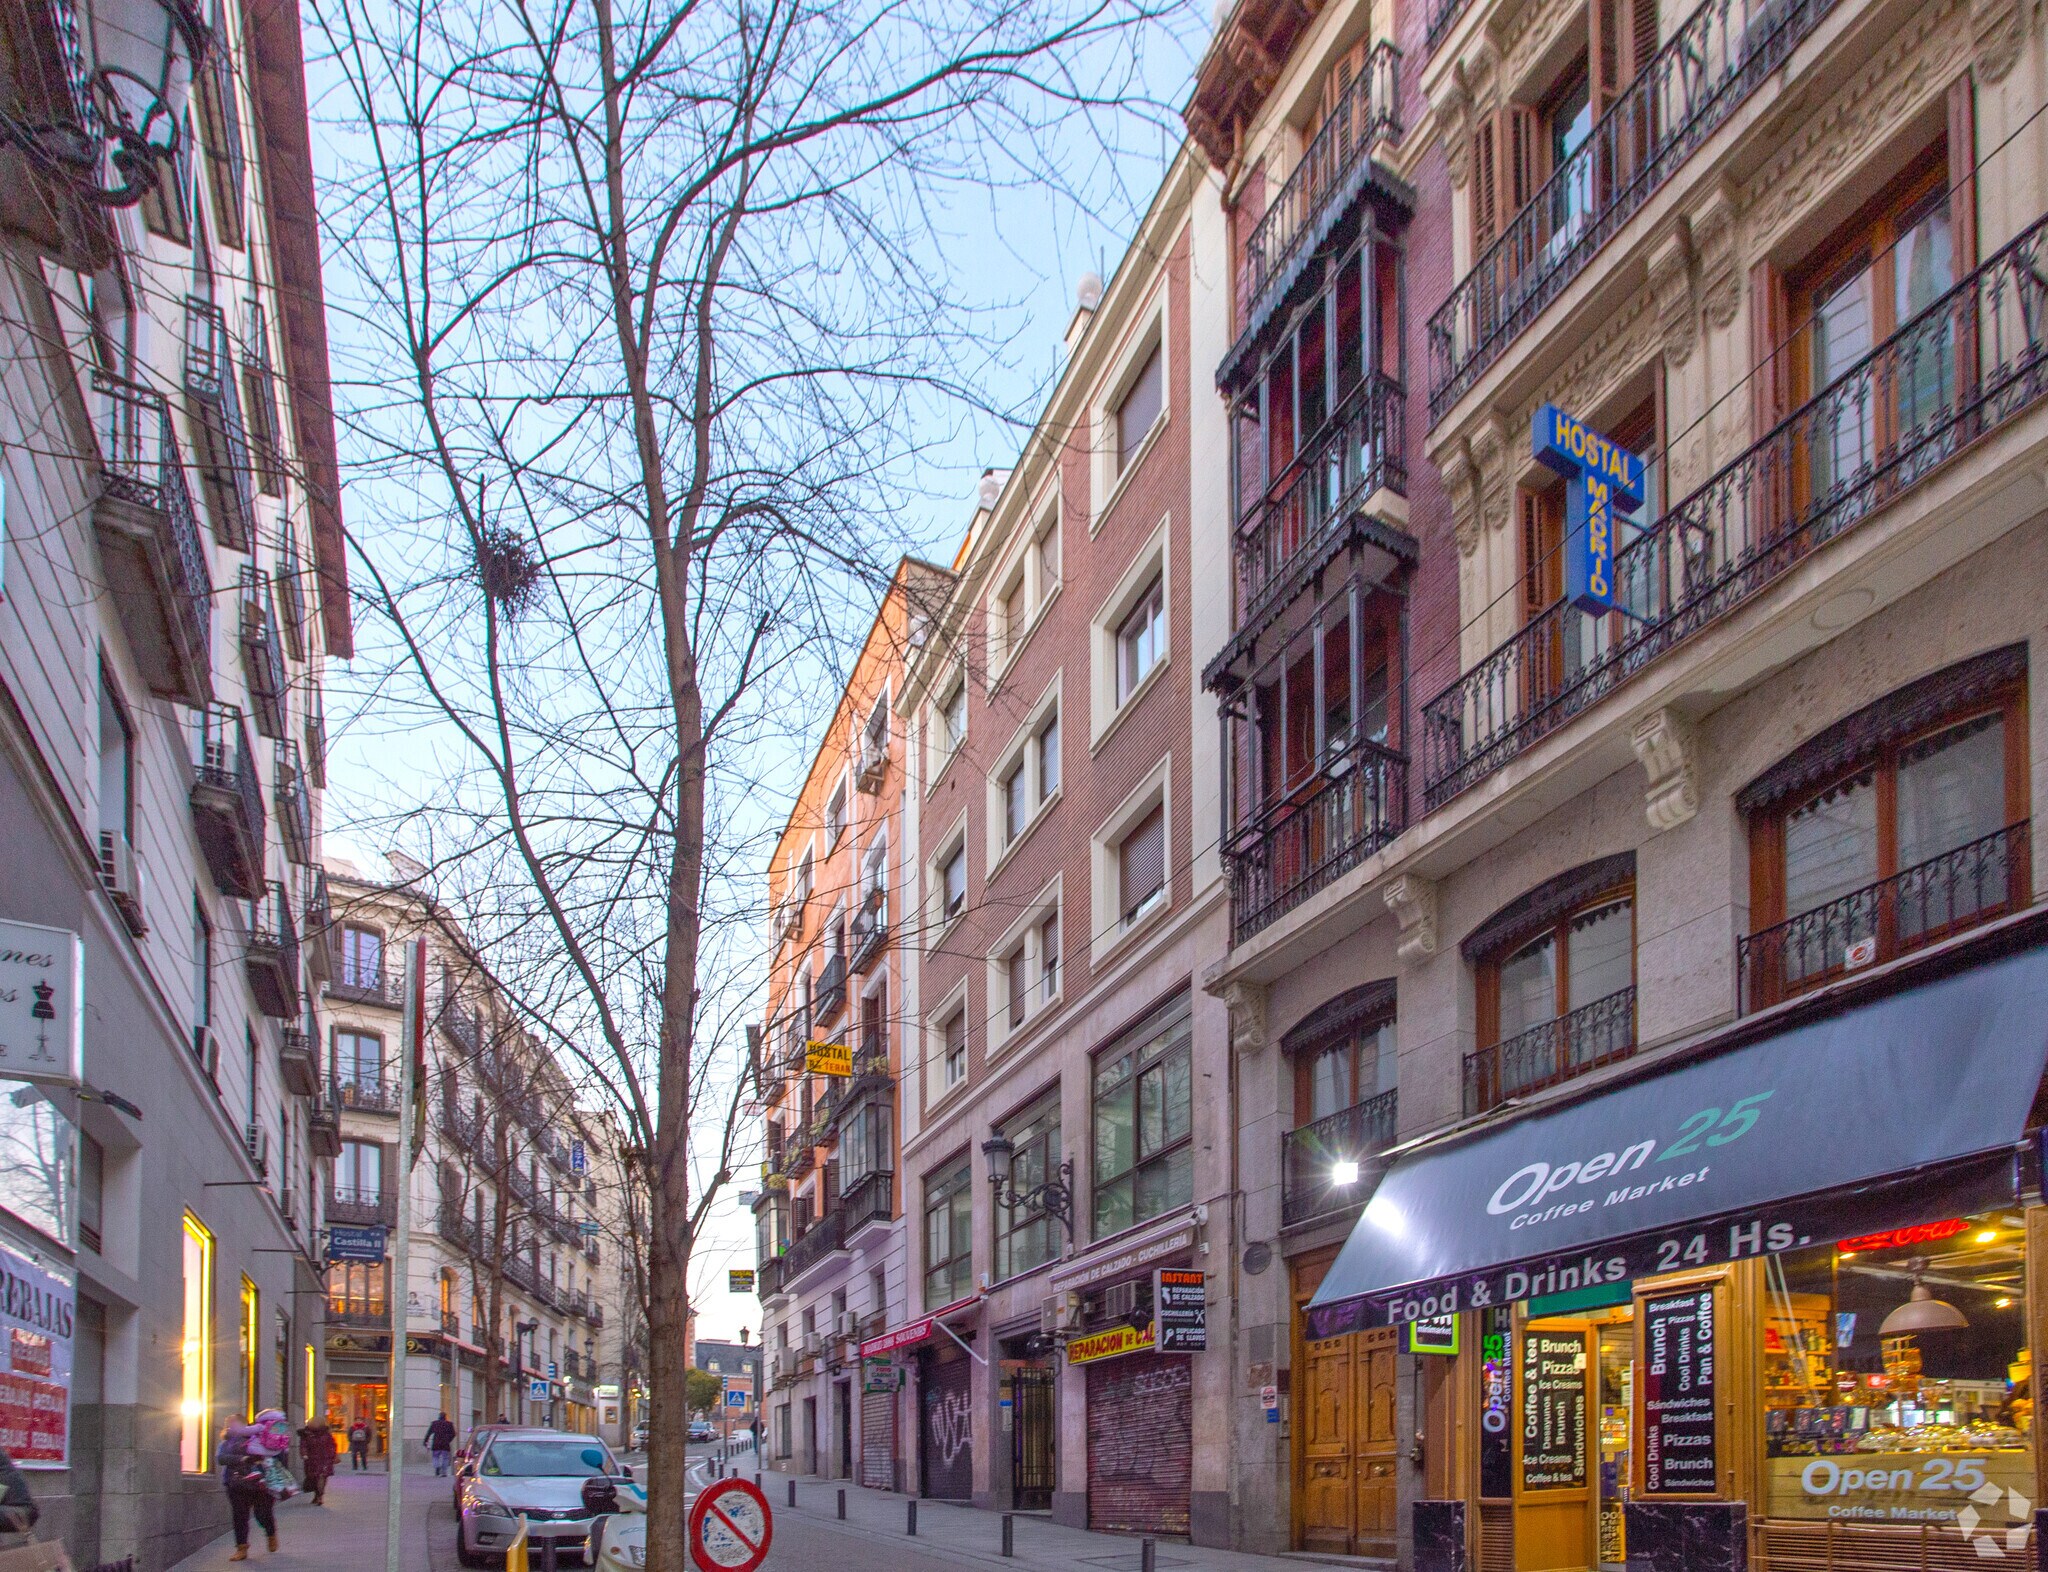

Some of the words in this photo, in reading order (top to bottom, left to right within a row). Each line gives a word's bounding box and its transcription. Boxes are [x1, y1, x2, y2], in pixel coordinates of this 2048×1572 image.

[1556, 414, 1635, 490] HOSTAL
[1587, 475, 1608, 597] MADRID
[809, 1044, 851, 1061] HOSTAL
[1486, 1139, 1656, 1217] Open
[1655, 1089, 1775, 1163] 25
[1509, 1198, 1595, 1231] Coffee
[1602, 1166, 1710, 1208] Market
[334, 1237, 373, 1247] Castilla
[1101, 1255, 1132, 1276] CALZADO
[1387, 1285, 1458, 1325] Food
[1470, 1280, 1492, 1307] &
[1504, 1252, 1628, 1299] Drinks
[1656, 1234, 1709, 1272] 24
[1729, 1220, 1810, 1258] Hs.
[1648, 1298, 1695, 1313] Breakfast
[1697, 1292, 1713, 1340] Coffee
[1668, 1314, 1696, 1325] Pizzas
[1484, 1335, 1503, 1366] 25
[1503, 1331, 1512, 1367] Market
[1525, 1338, 1538, 1364] tea
[1541, 1339, 1582, 1353] Brunch
[1650, 1317, 1667, 1375] Brunch
[1679, 1327, 1691, 1364] Drinks
[1697, 1342, 1713, 1355] &
[1525, 1367, 1538, 1380] &
[1539, 1380, 1551, 1389] Ice
[1552, 1379, 1583, 1390] Creams
[1679, 1365, 1691, 1392] Cool
[1697, 1357, 1713, 1385] Pan
[1503, 1369, 1512, 1402] Coffee
[1482, 1370, 1506, 1433] Open
[1525, 1384, 1538, 1438] Coffee
[1556, 1401, 1566, 1445] Brunch
[1661, 1411, 1714, 1424] Breakfast
[1647, 1425, 1660, 1462] Drinks
[1663, 1433, 1712, 1447] Pizzas
[1539, 1453, 1572, 1465] Creams
[1664, 1457, 1714, 1470] Brunch
[1526, 1472, 1552, 1484] Coffee
[1552, 1472, 1559, 1482] &
[1647, 1463, 1660, 1490] Cool
[1801, 1460, 1913, 1495] Open
[1919, 1458, 1987, 1491] 25
[1828, 1505, 1885, 1519] Coffee
[1890, 1507, 1958, 1521] Market
